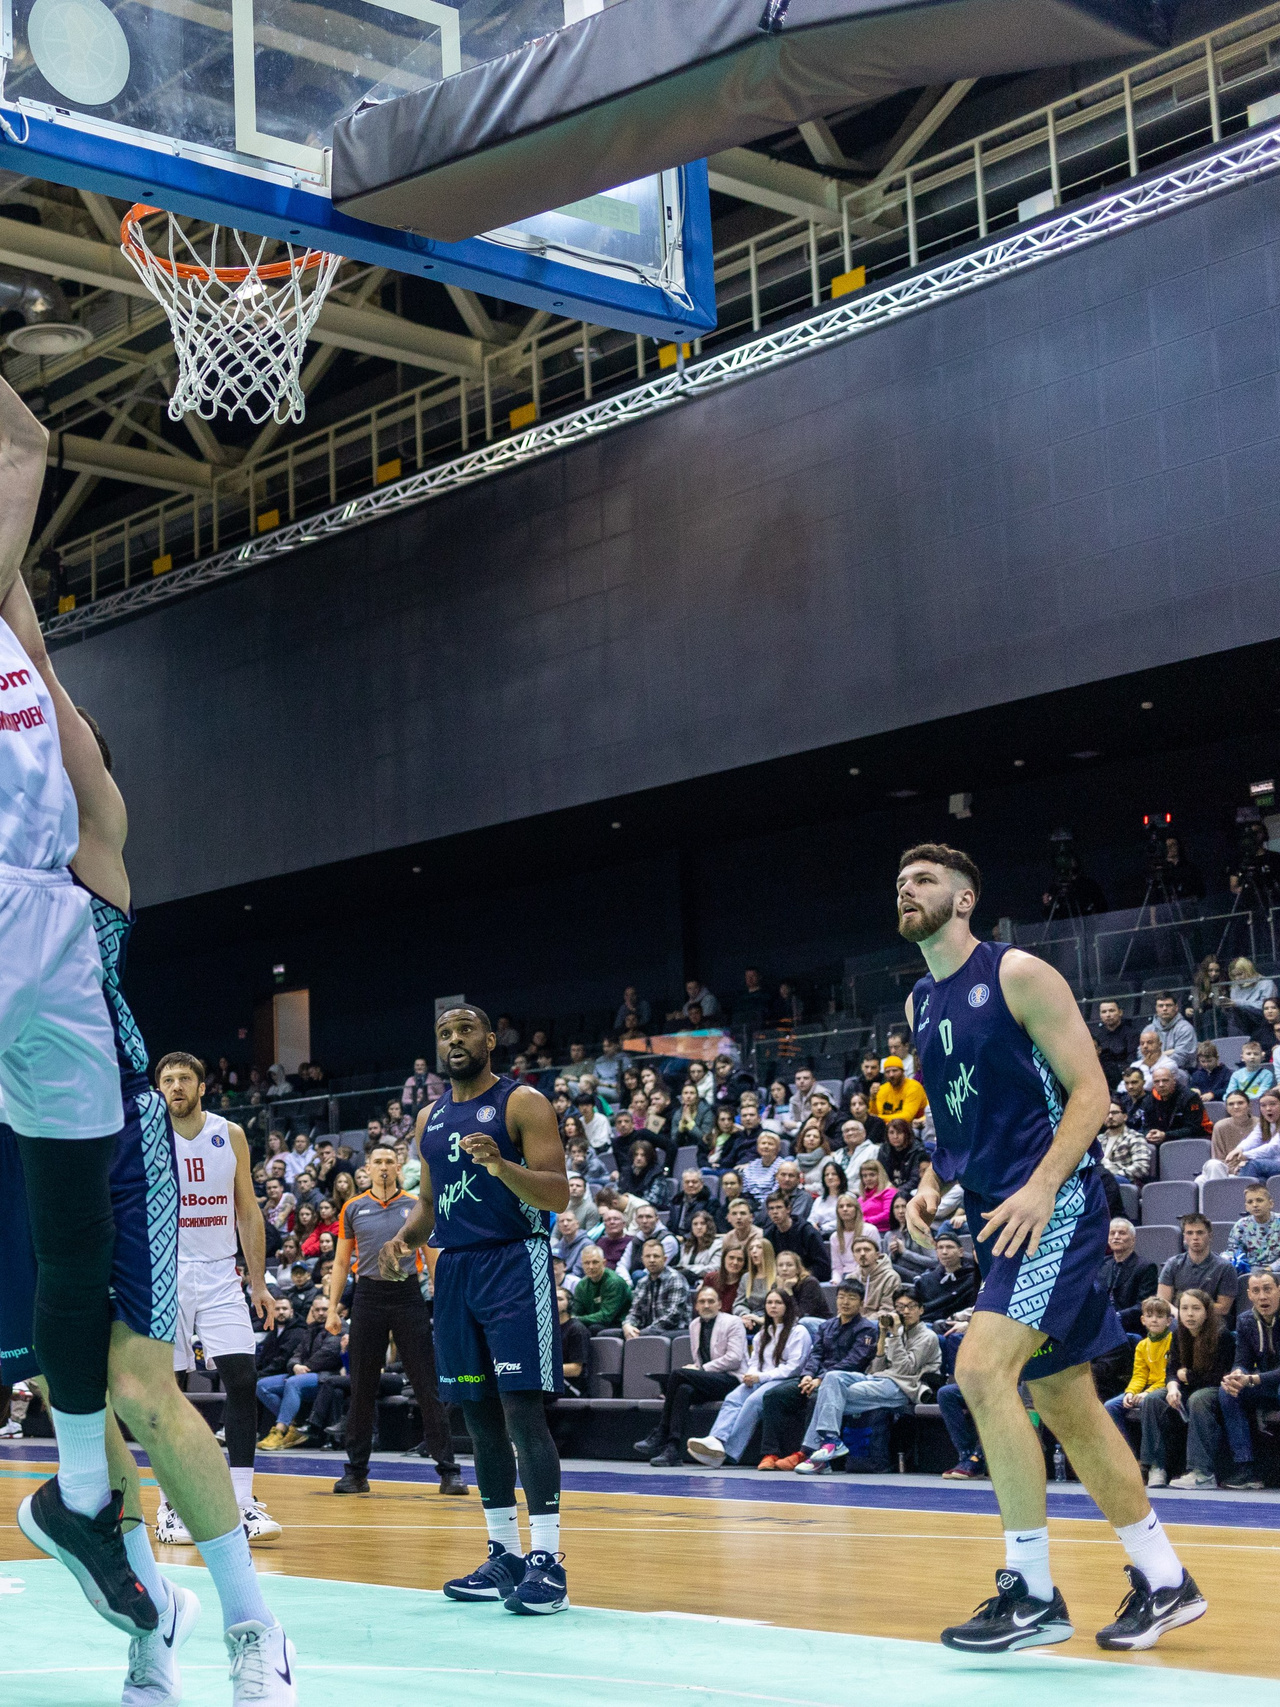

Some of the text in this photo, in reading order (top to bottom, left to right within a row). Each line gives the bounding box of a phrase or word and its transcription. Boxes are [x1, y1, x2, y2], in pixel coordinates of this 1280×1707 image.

[427, 1122, 444, 1133] Kempa
[447, 1132, 461, 1163] 3
[183, 1157, 206, 1183] 18
[0, 1346, 29, 1359] empa
